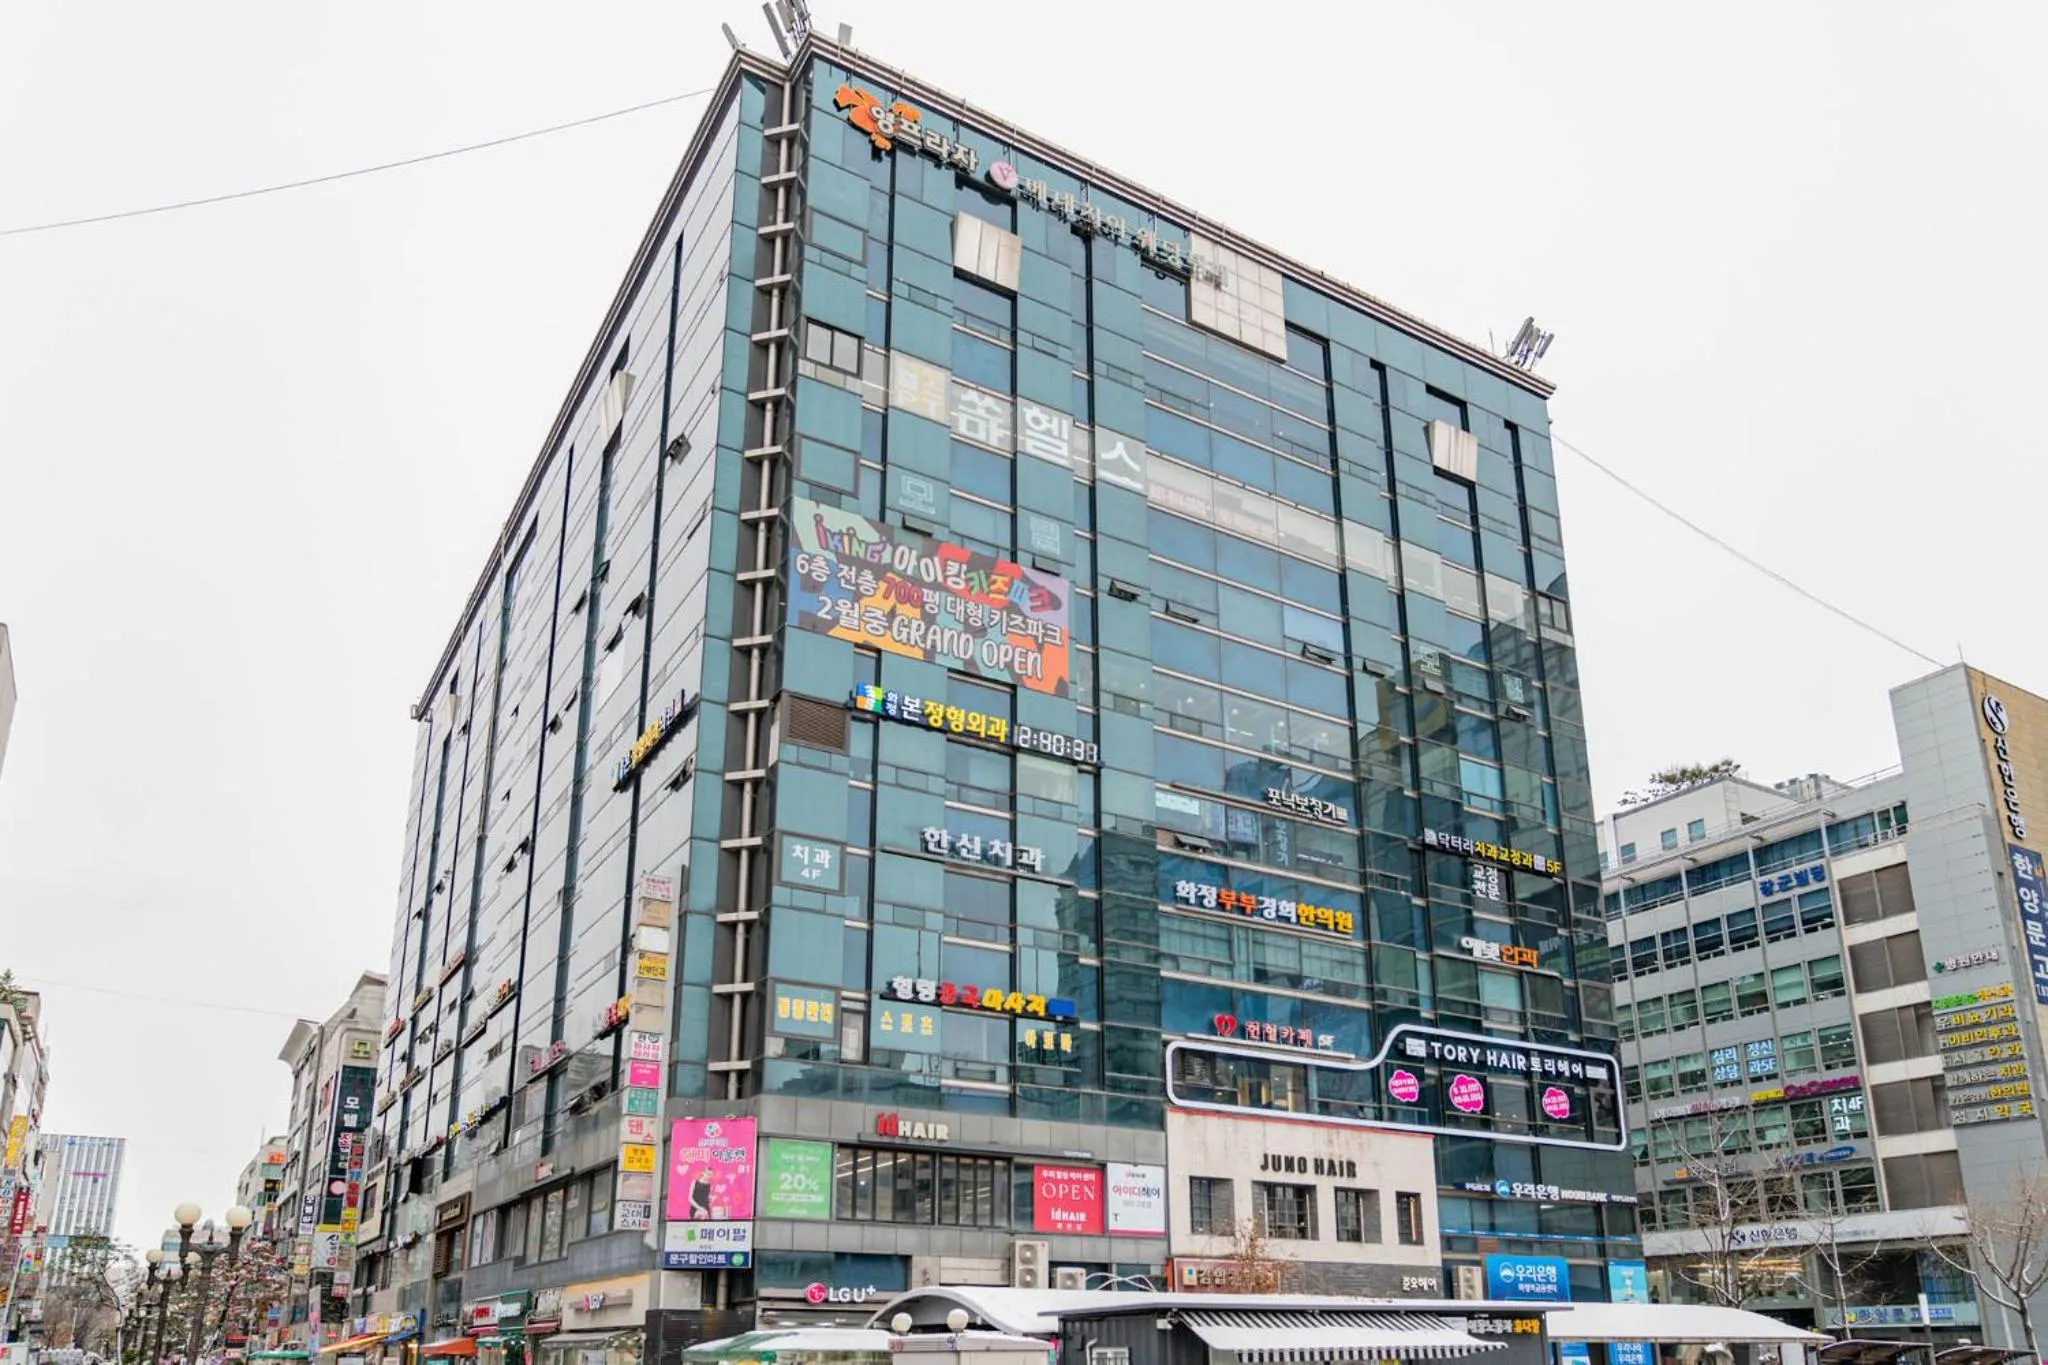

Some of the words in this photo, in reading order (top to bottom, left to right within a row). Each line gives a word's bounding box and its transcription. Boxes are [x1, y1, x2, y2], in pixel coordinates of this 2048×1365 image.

[871, 105, 979, 174] 영프라자
[796, 553, 831, 582] 6층
[892, 613, 974, 661] GRAND
[982, 643, 1043, 681] OPEN
[791, 844, 831, 869] 치과
[922, 827, 1045, 872] 한신치과
[801, 869, 821, 880] 4F
[1547, 858, 1562, 874] 5F
[1712, 1048, 1737, 1062] 심리
[1748, 1040, 1774, 1056] 정신
[1431, 1042, 1481, 1063] TORY
[1487, 1052, 1526, 1071] HAIR
[1530, 1057, 1583, 1078] 토리헤어
[1714, 1065, 1738, 1080] 상담
[1848, 1096, 1863, 1110] 4F
[1260, 1153, 1308, 1175] JUNO
[1314, 1158, 1357, 1179] HAIR
[780, 1172, 819, 1191] 20%
[1042, 1182, 1096, 1201] OPEN
[1112, 1184, 1160, 1199] 아이디헤어
[1512, 1182, 1559, 1201] 우리은행
[1515, 1264, 1557, 1282] 우리은행
